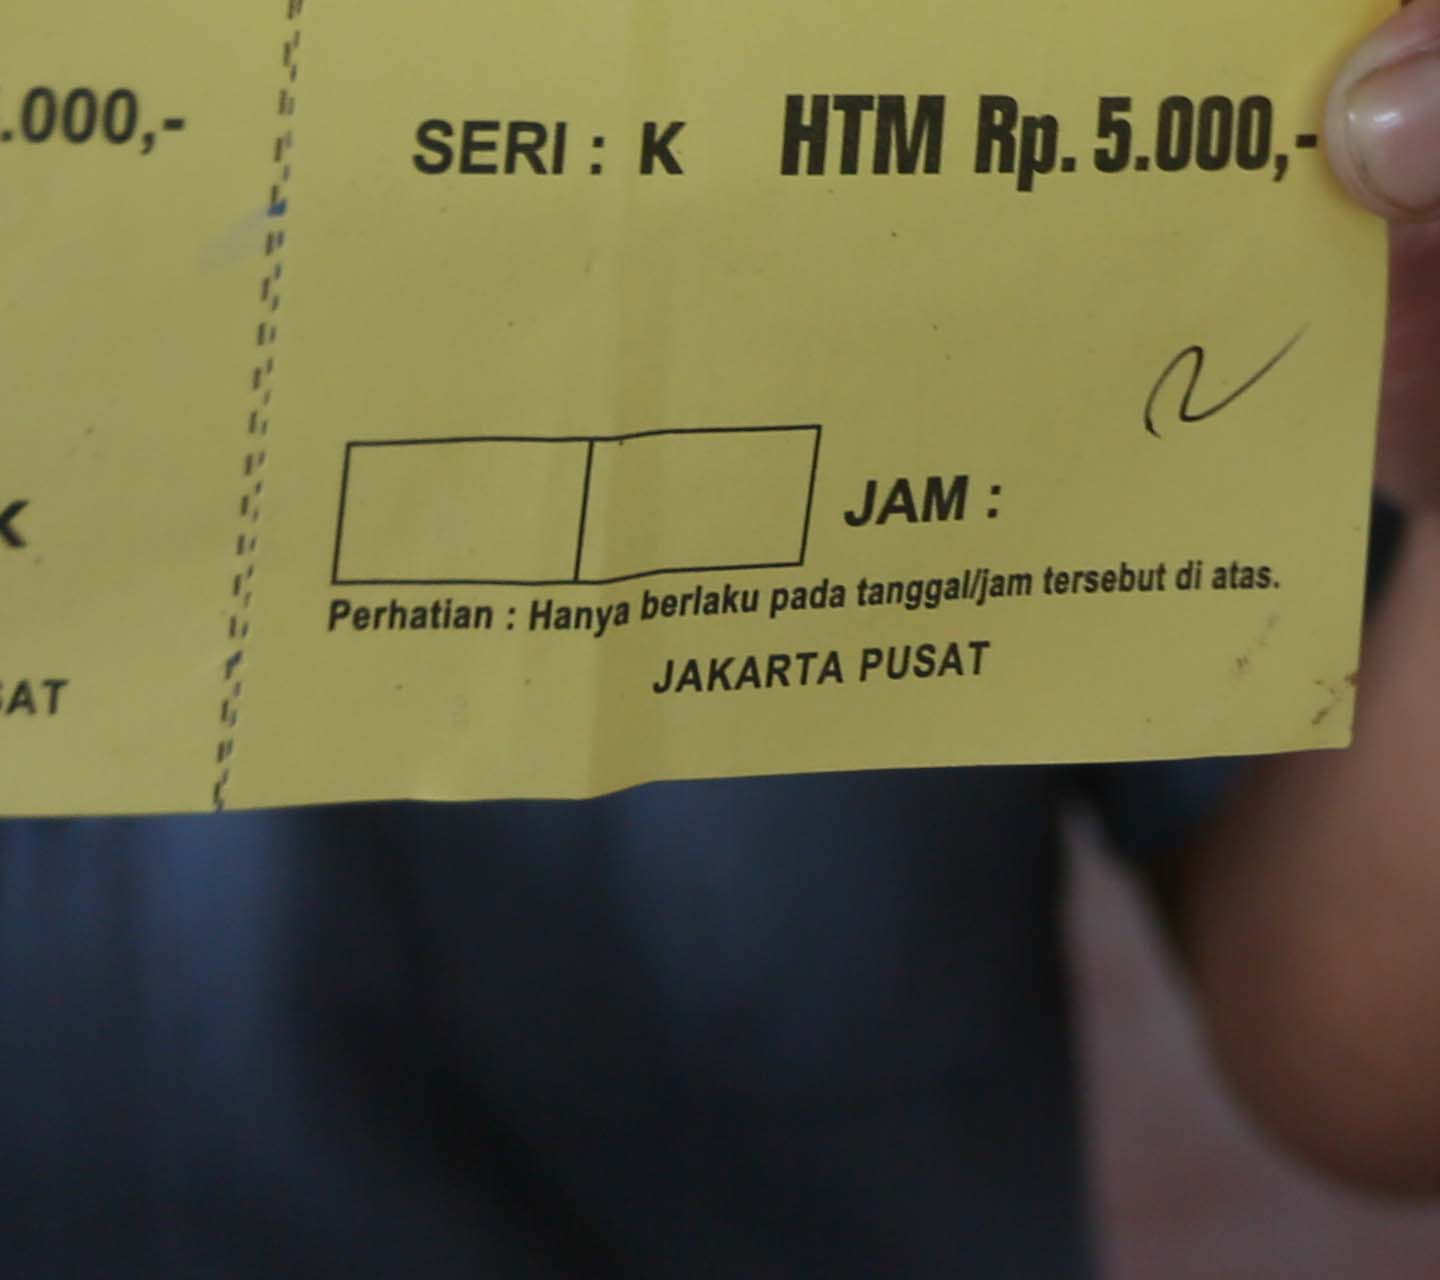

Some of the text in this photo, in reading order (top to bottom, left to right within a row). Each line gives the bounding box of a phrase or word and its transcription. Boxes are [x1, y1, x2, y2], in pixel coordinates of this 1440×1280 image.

[411, 117, 569, 177] SERI
[638, 120, 687, 177] K
[779, 92, 1319, 194] HTM Rp. 5.000,-
[842, 473, 971, 529] JAM
[326, 596, 495, 633] Perhatian
[527, 597, 632, 640] Hanya
[639, 582, 761, 622] berlaku
[768, 576, 848, 621] pada
[855, 566, 1034, 612] tanggal/jam
[1042, 560, 1168, 597] tersebut
[1174, 558, 1204, 592] di
[1210, 559, 1281, 591] atas.
[651, 639, 992, 696] JAKARTA PUSAT
